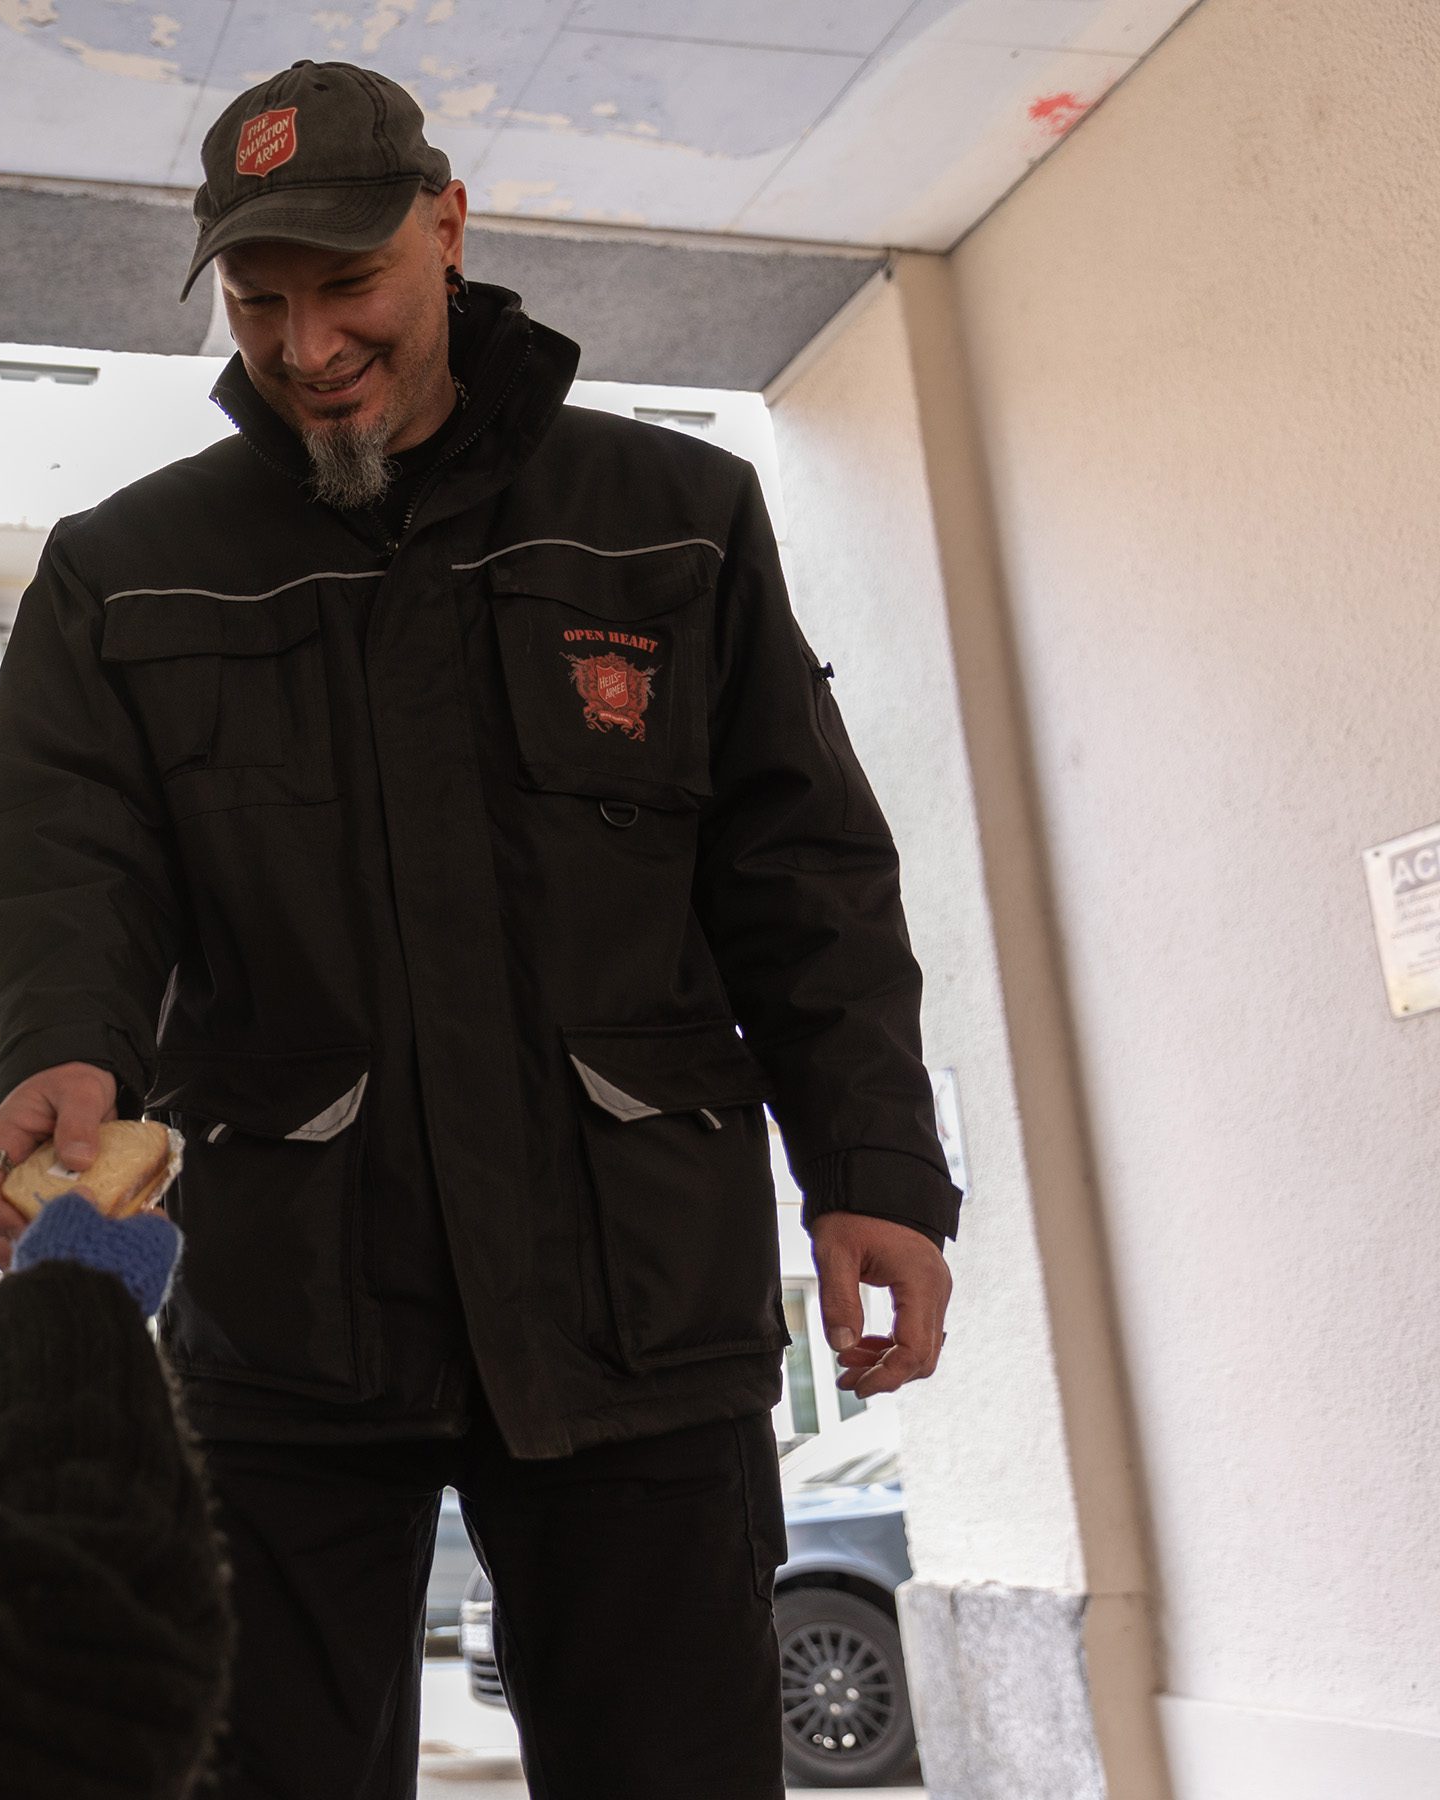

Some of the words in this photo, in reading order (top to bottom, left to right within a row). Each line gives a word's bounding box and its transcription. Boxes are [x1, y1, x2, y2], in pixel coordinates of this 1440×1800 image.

[239, 116, 290, 165] SALVATION
[247, 115, 269, 141] THE
[254, 133, 288, 168] ARMY
[563, 629, 605, 641] OPEN
[608, 632, 658, 653] HEART
[605, 682, 625, 699] ARMEE
